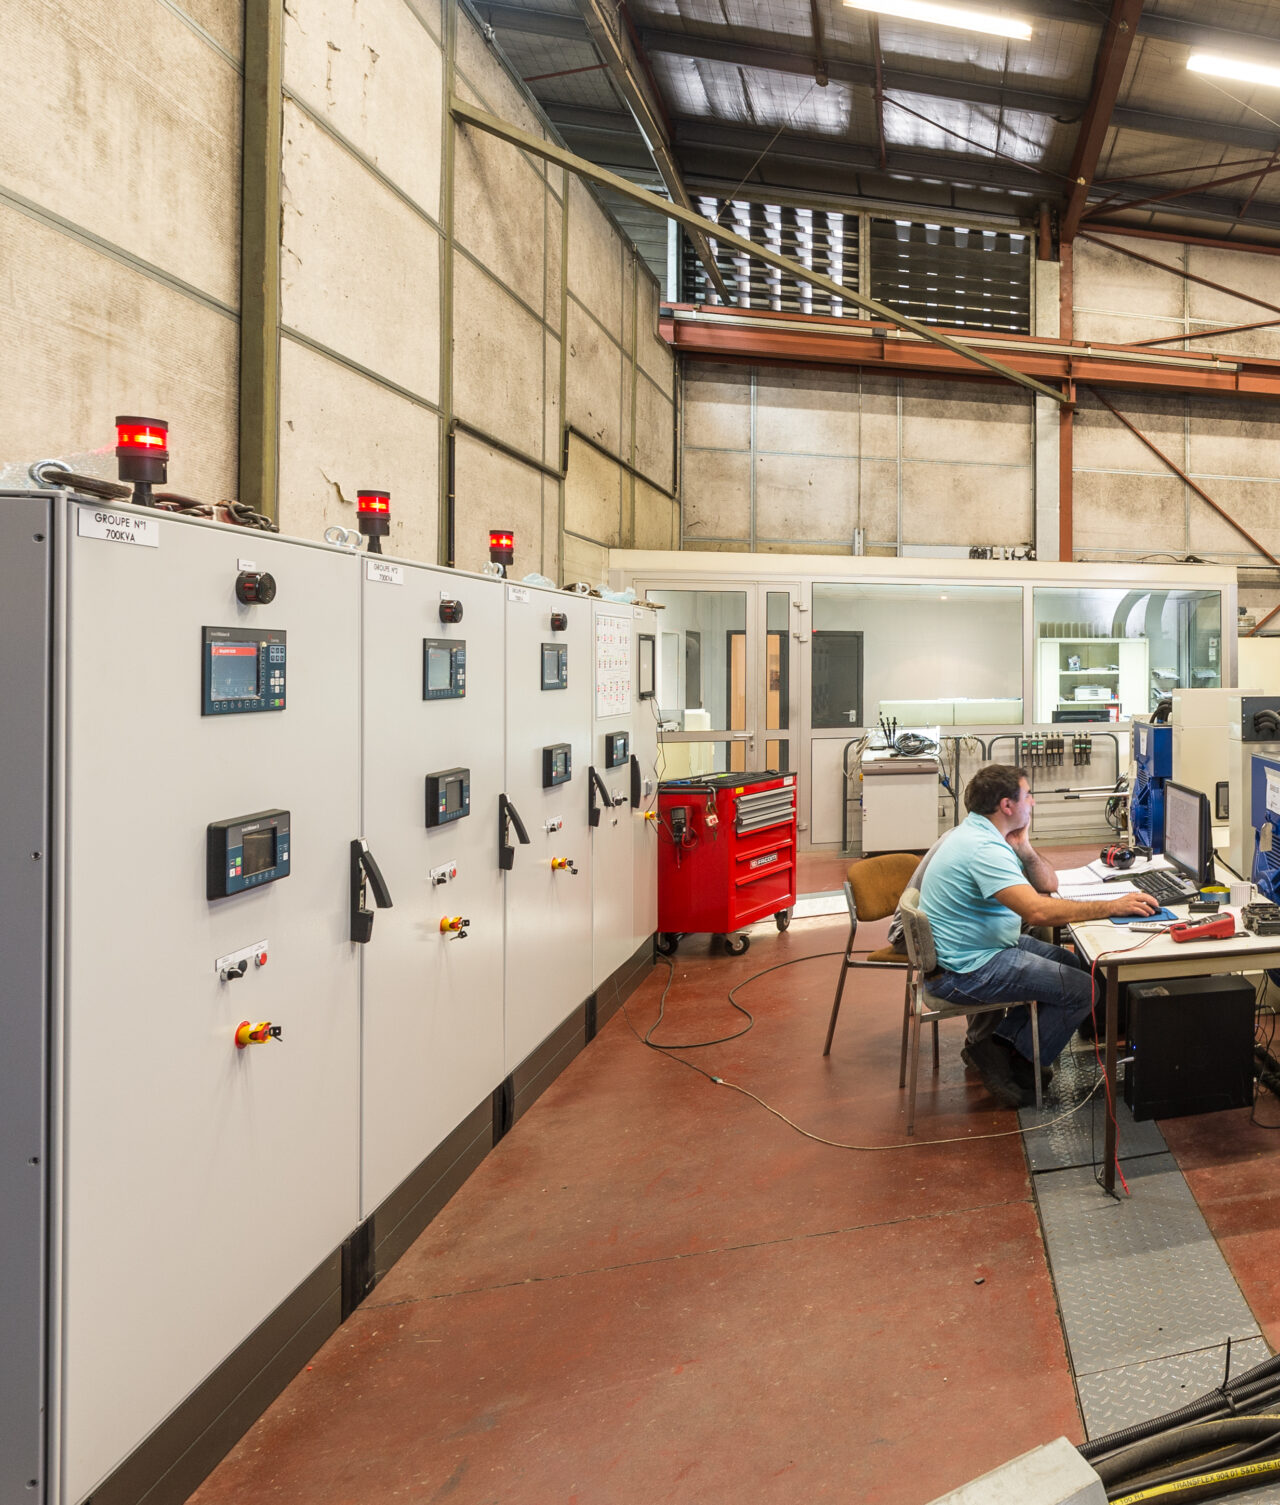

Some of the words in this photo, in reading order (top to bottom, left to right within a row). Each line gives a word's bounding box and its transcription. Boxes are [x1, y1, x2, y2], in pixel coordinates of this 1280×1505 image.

[94, 512, 130, 528] GROUPE
[105, 528, 136, 542] 700KVA
[1172, 1475, 1215, 1490] TRANSFLEX
[1216, 1472, 1230, 1480] 904
[1240, 1466, 1256, 1475] S&D
[1257, 1463, 1272, 1472] SAE
